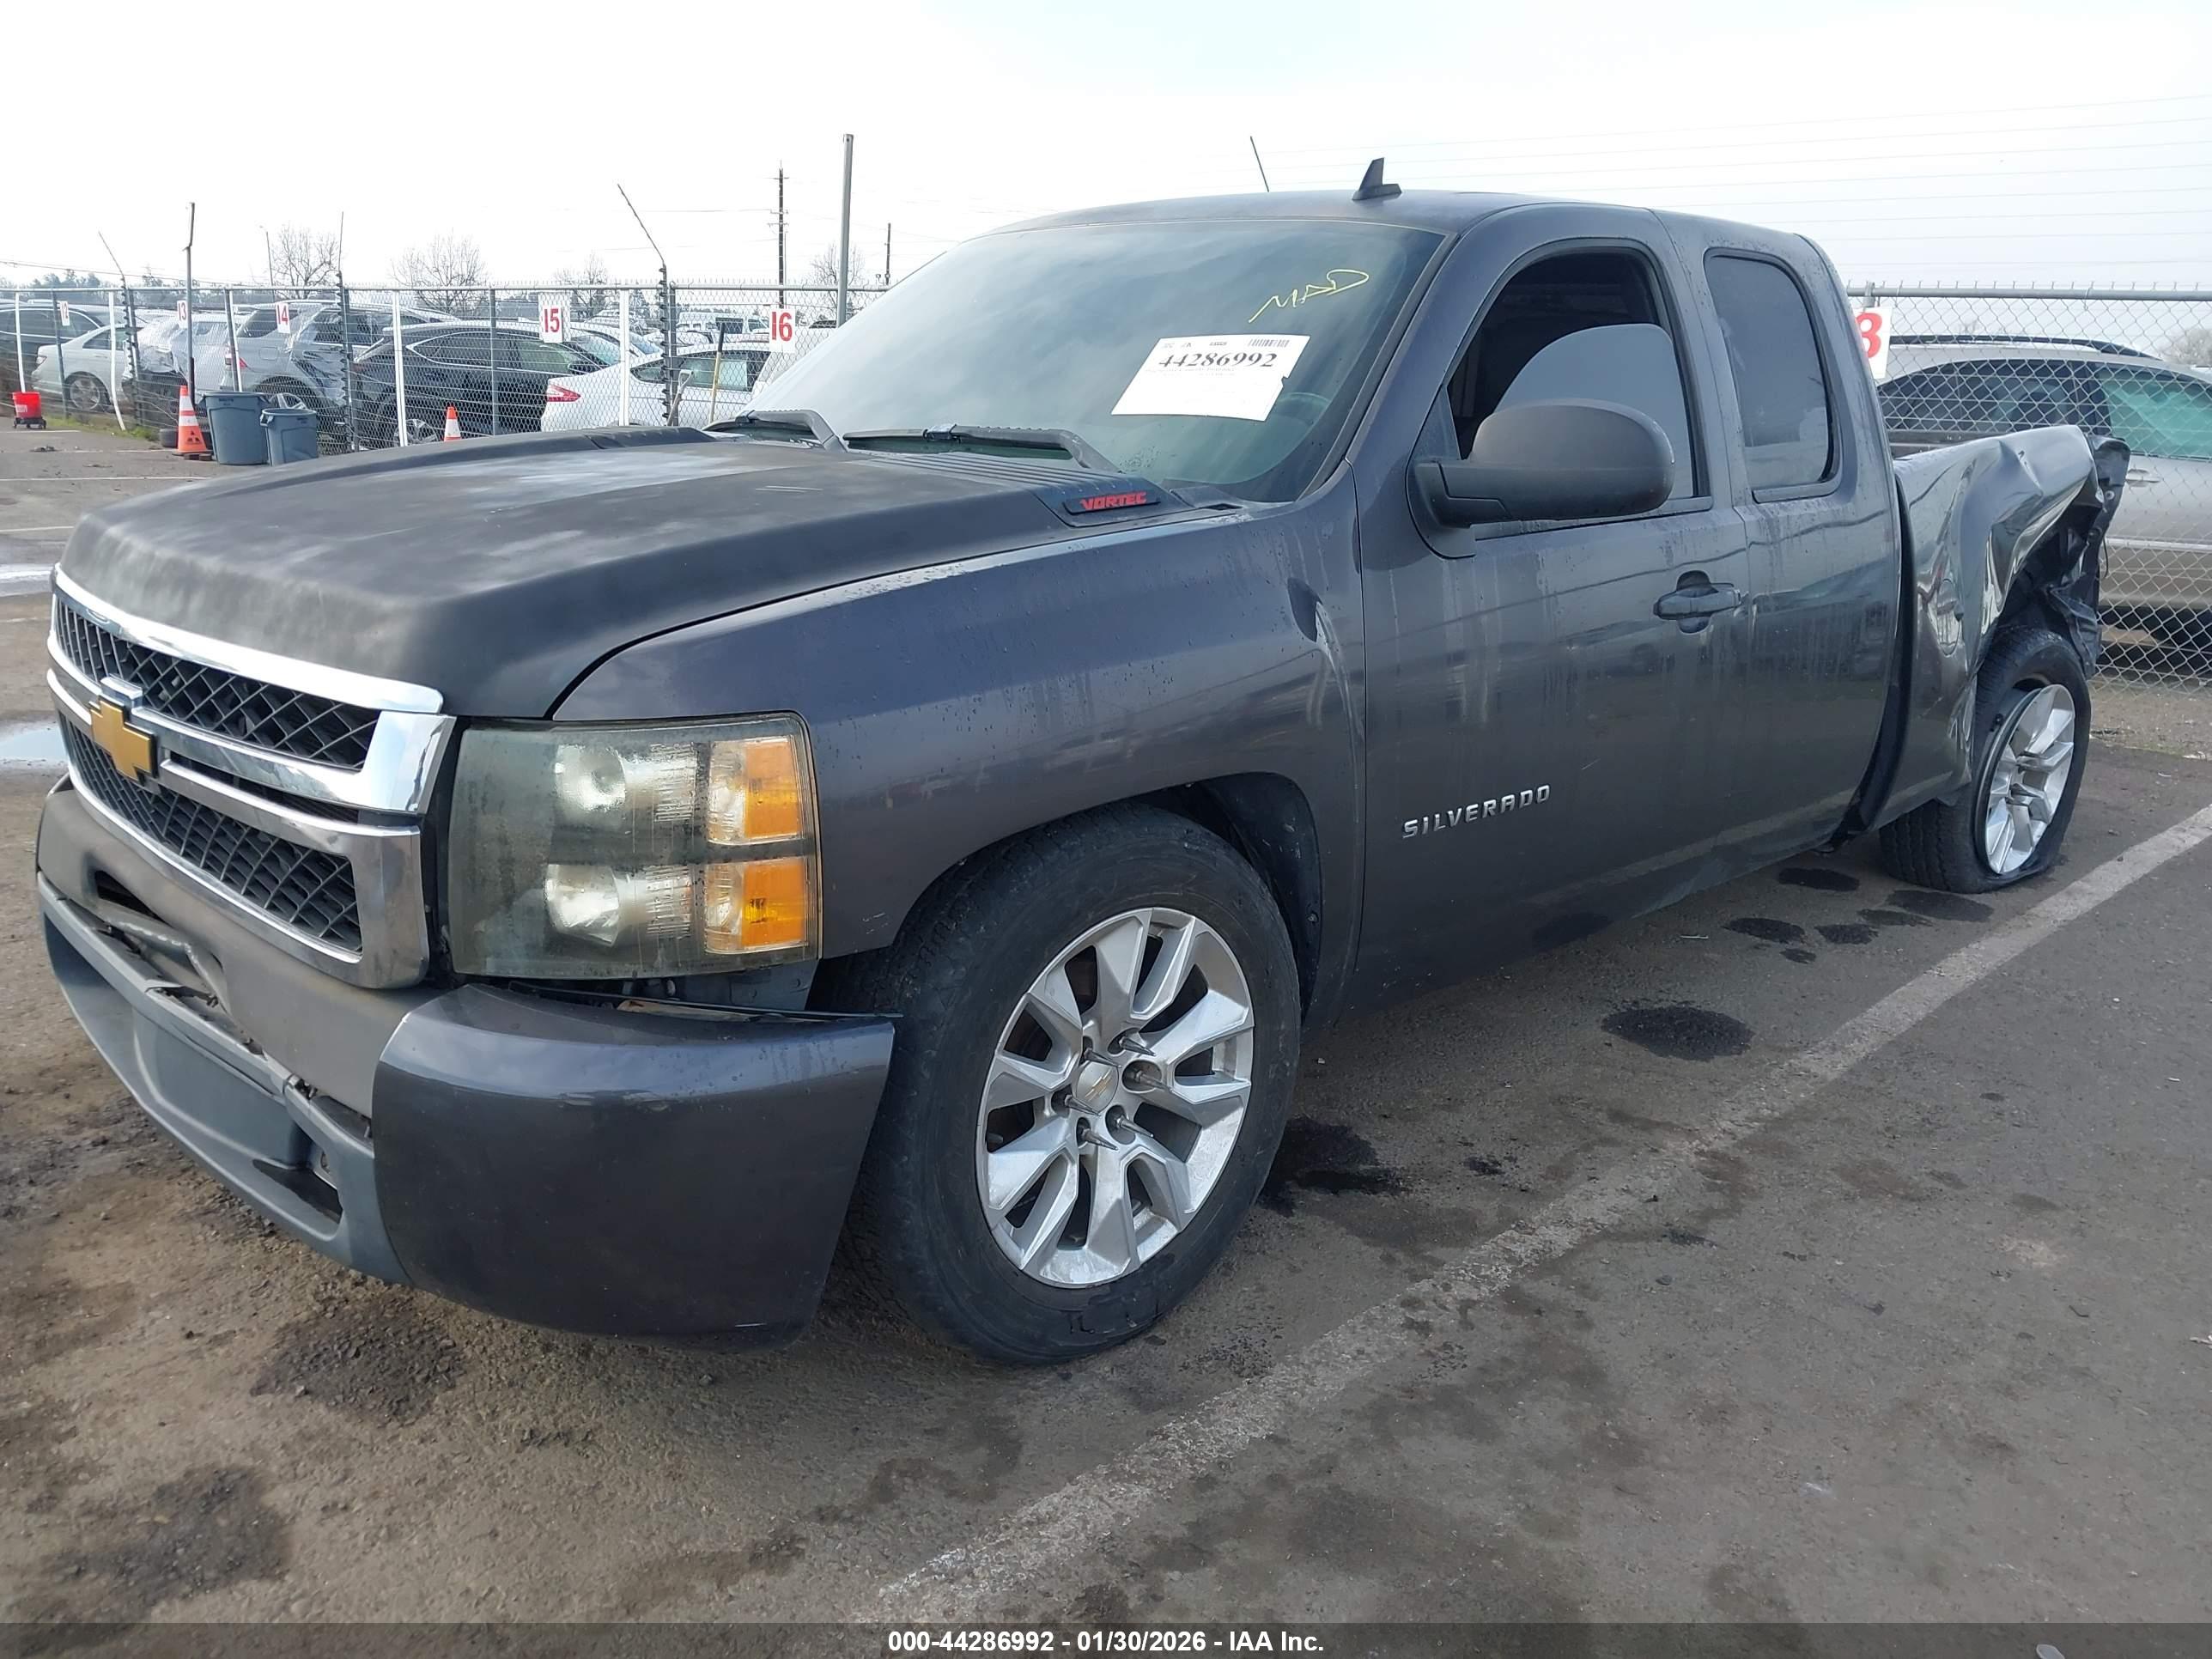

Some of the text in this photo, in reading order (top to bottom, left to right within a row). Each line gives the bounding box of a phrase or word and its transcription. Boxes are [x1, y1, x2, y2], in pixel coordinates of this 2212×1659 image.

[178, 302, 187, 321] 13
[276, 305, 289, 325] 14
[544, 308, 560, 333] 15
[772, 312, 793, 342] 16
[1158, 352, 1278, 368] 44286992
[1079, 492, 1147, 511] VORTEC
[1402, 784, 1551, 839] SILVERADO
